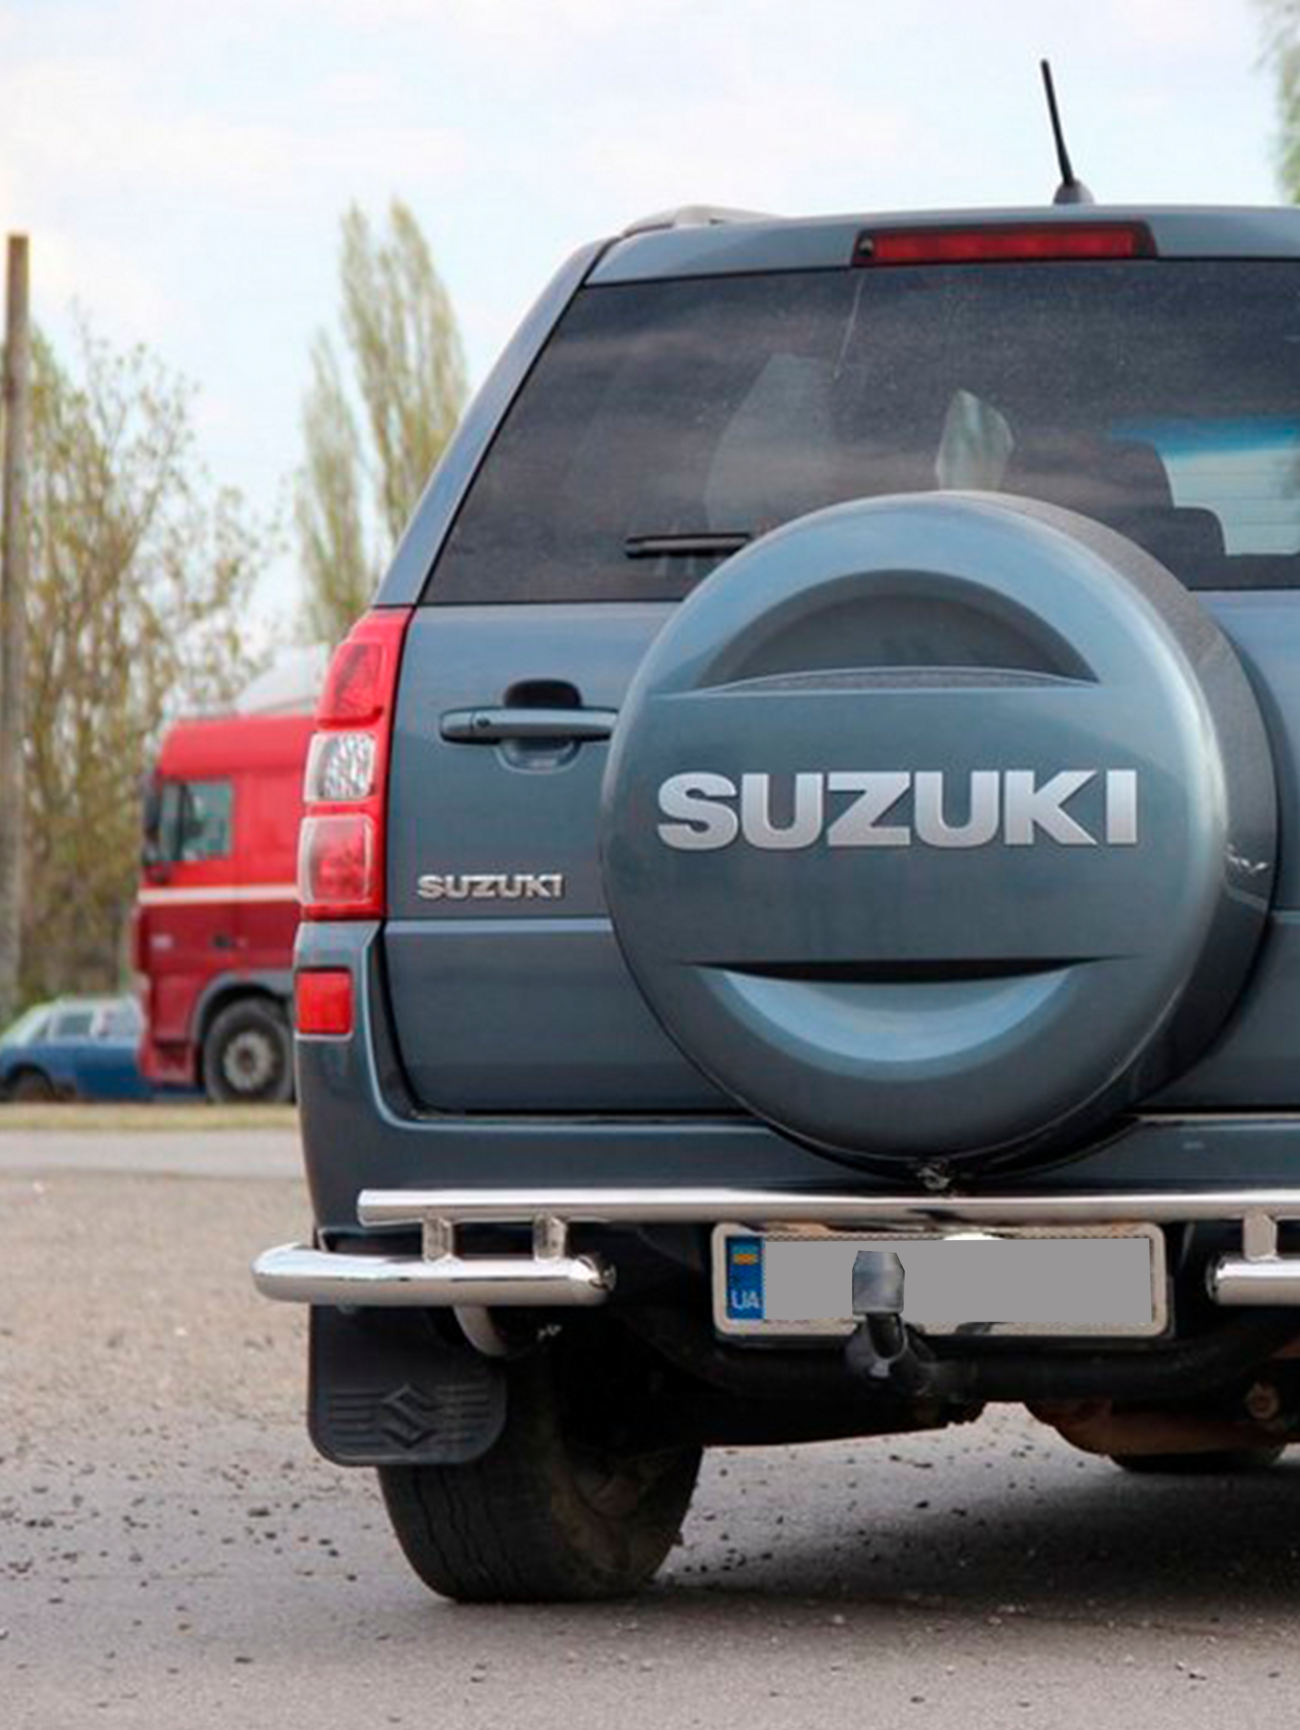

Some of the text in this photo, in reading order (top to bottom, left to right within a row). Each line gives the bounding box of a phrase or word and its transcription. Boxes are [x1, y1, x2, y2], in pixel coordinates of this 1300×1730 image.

[657, 769, 1137, 849] SUZUKI
[417, 873, 564, 899] SUZUKI
[731, 1289, 760, 1310] UA
